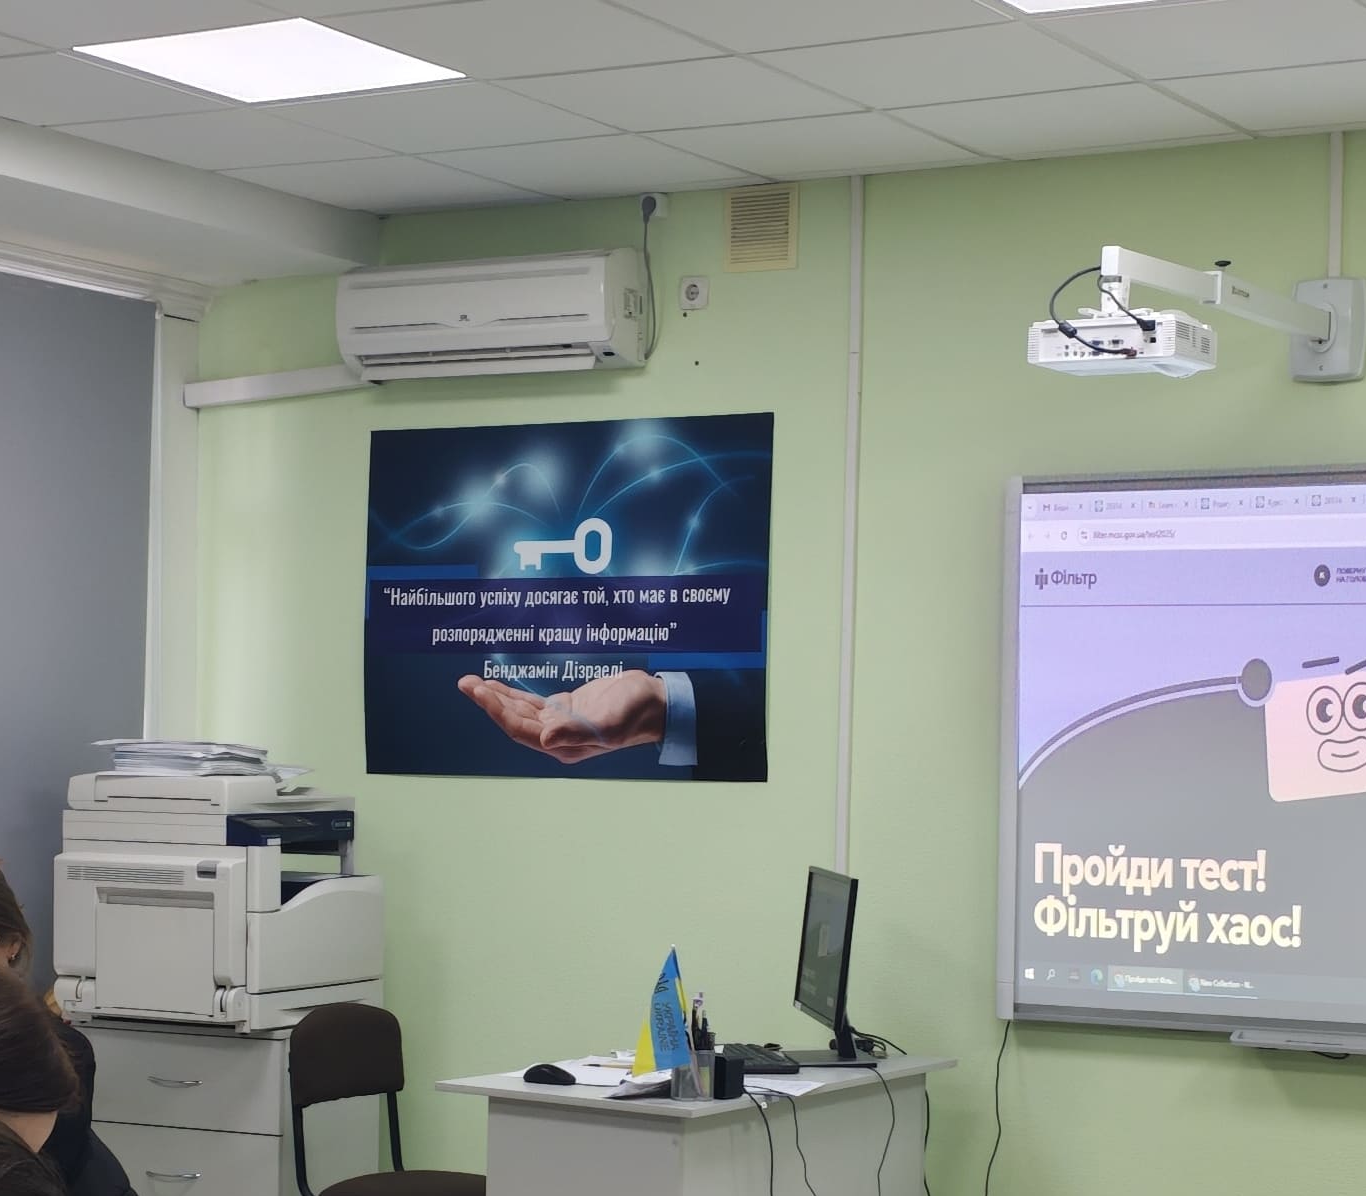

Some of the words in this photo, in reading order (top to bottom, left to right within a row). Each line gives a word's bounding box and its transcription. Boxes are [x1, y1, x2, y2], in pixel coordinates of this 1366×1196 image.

[1051, 569, 1097, 589] Фільтр
[480, 589, 521, 608] успіху
[525, 589, 578, 607] досягає
[582, 588, 609, 605] той,
[613, 590, 635, 604] хто
[639, 588, 666, 603] має
[670, 590, 678, 602] в
[682, 587, 730, 605] своєму
[432, 624, 534, 645] розпорядженні
[538, 626, 582, 644] кращу
[483, 660, 558, 681] Бенджамін
[561, 660, 623, 681] Дізраелі
[1035, 842, 1173, 897] Пройди
[1181, 849, 1267, 892] тест!
[1035, 894, 1198, 954] Фільтруй
[1207, 905, 1302, 948] хаос!
